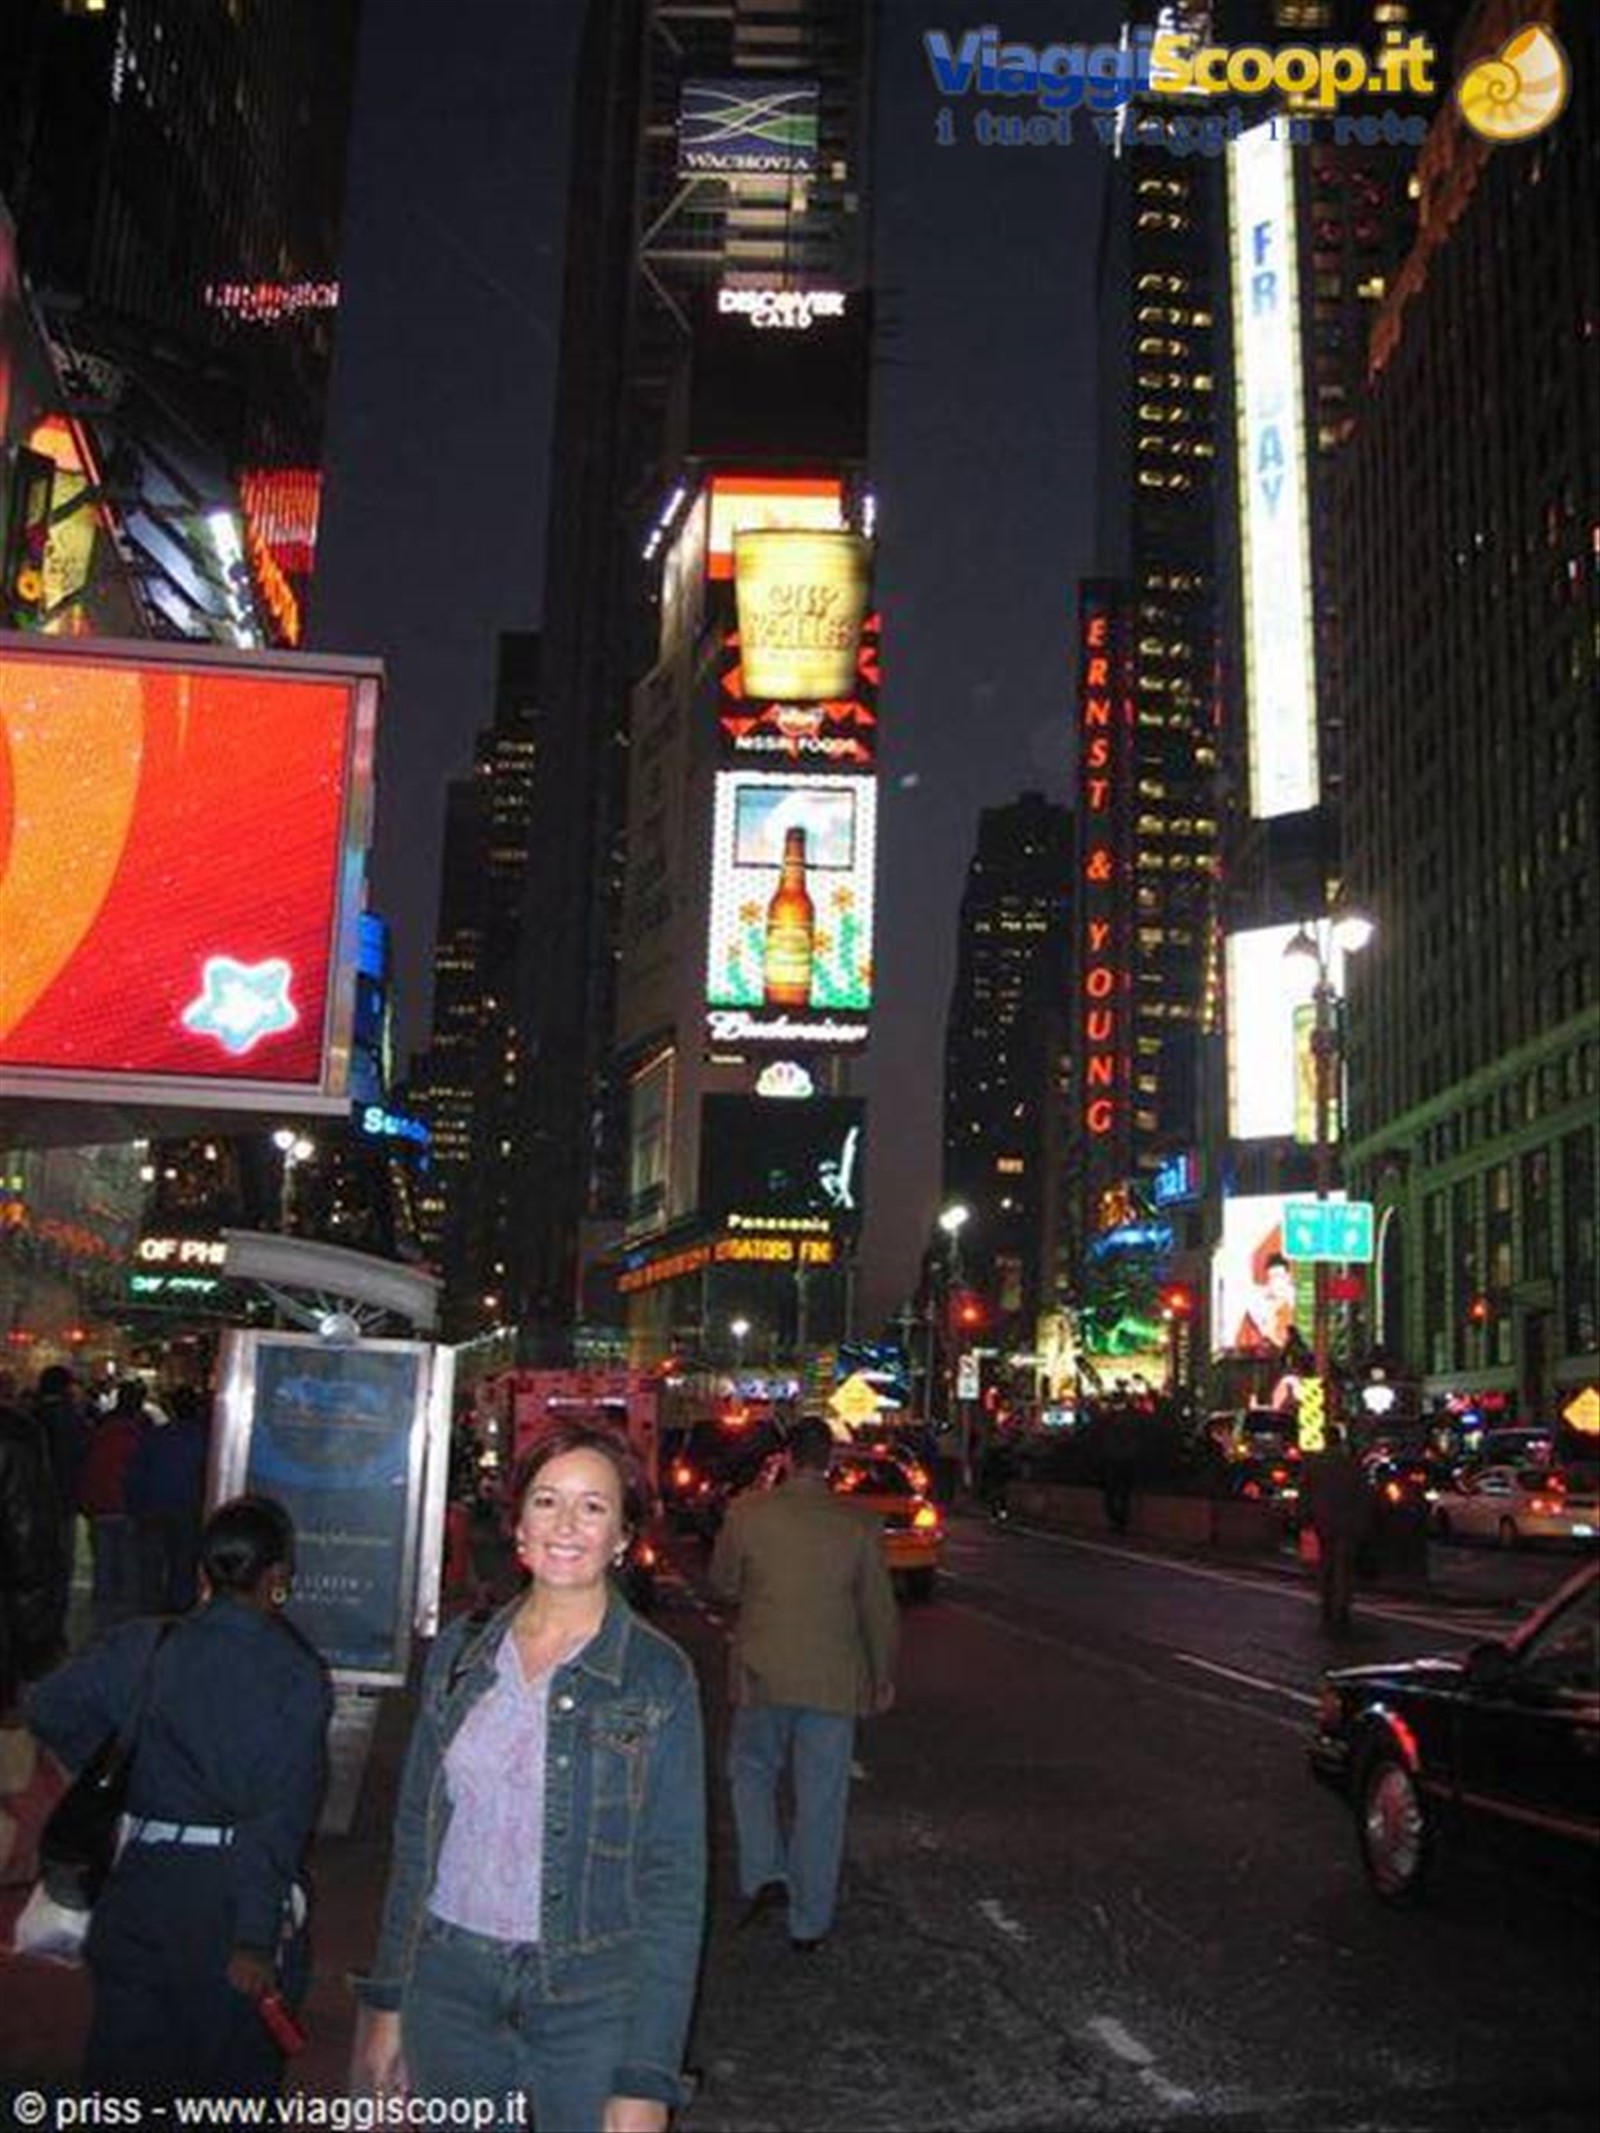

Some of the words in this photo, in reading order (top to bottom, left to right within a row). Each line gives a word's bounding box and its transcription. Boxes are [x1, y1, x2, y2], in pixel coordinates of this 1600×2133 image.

[685, 153, 811, 171] WACHOVIA
[718, 290, 846, 315] DISCOVER
[1088, 619, 1108, 808] ERNST
[707, 1011, 867, 1041] Budweiser
[1087, 923, 1112, 1131] YOUNG
[727, 1214, 829, 1231] Panasonic
[141, 1238, 178, 1261] OF
